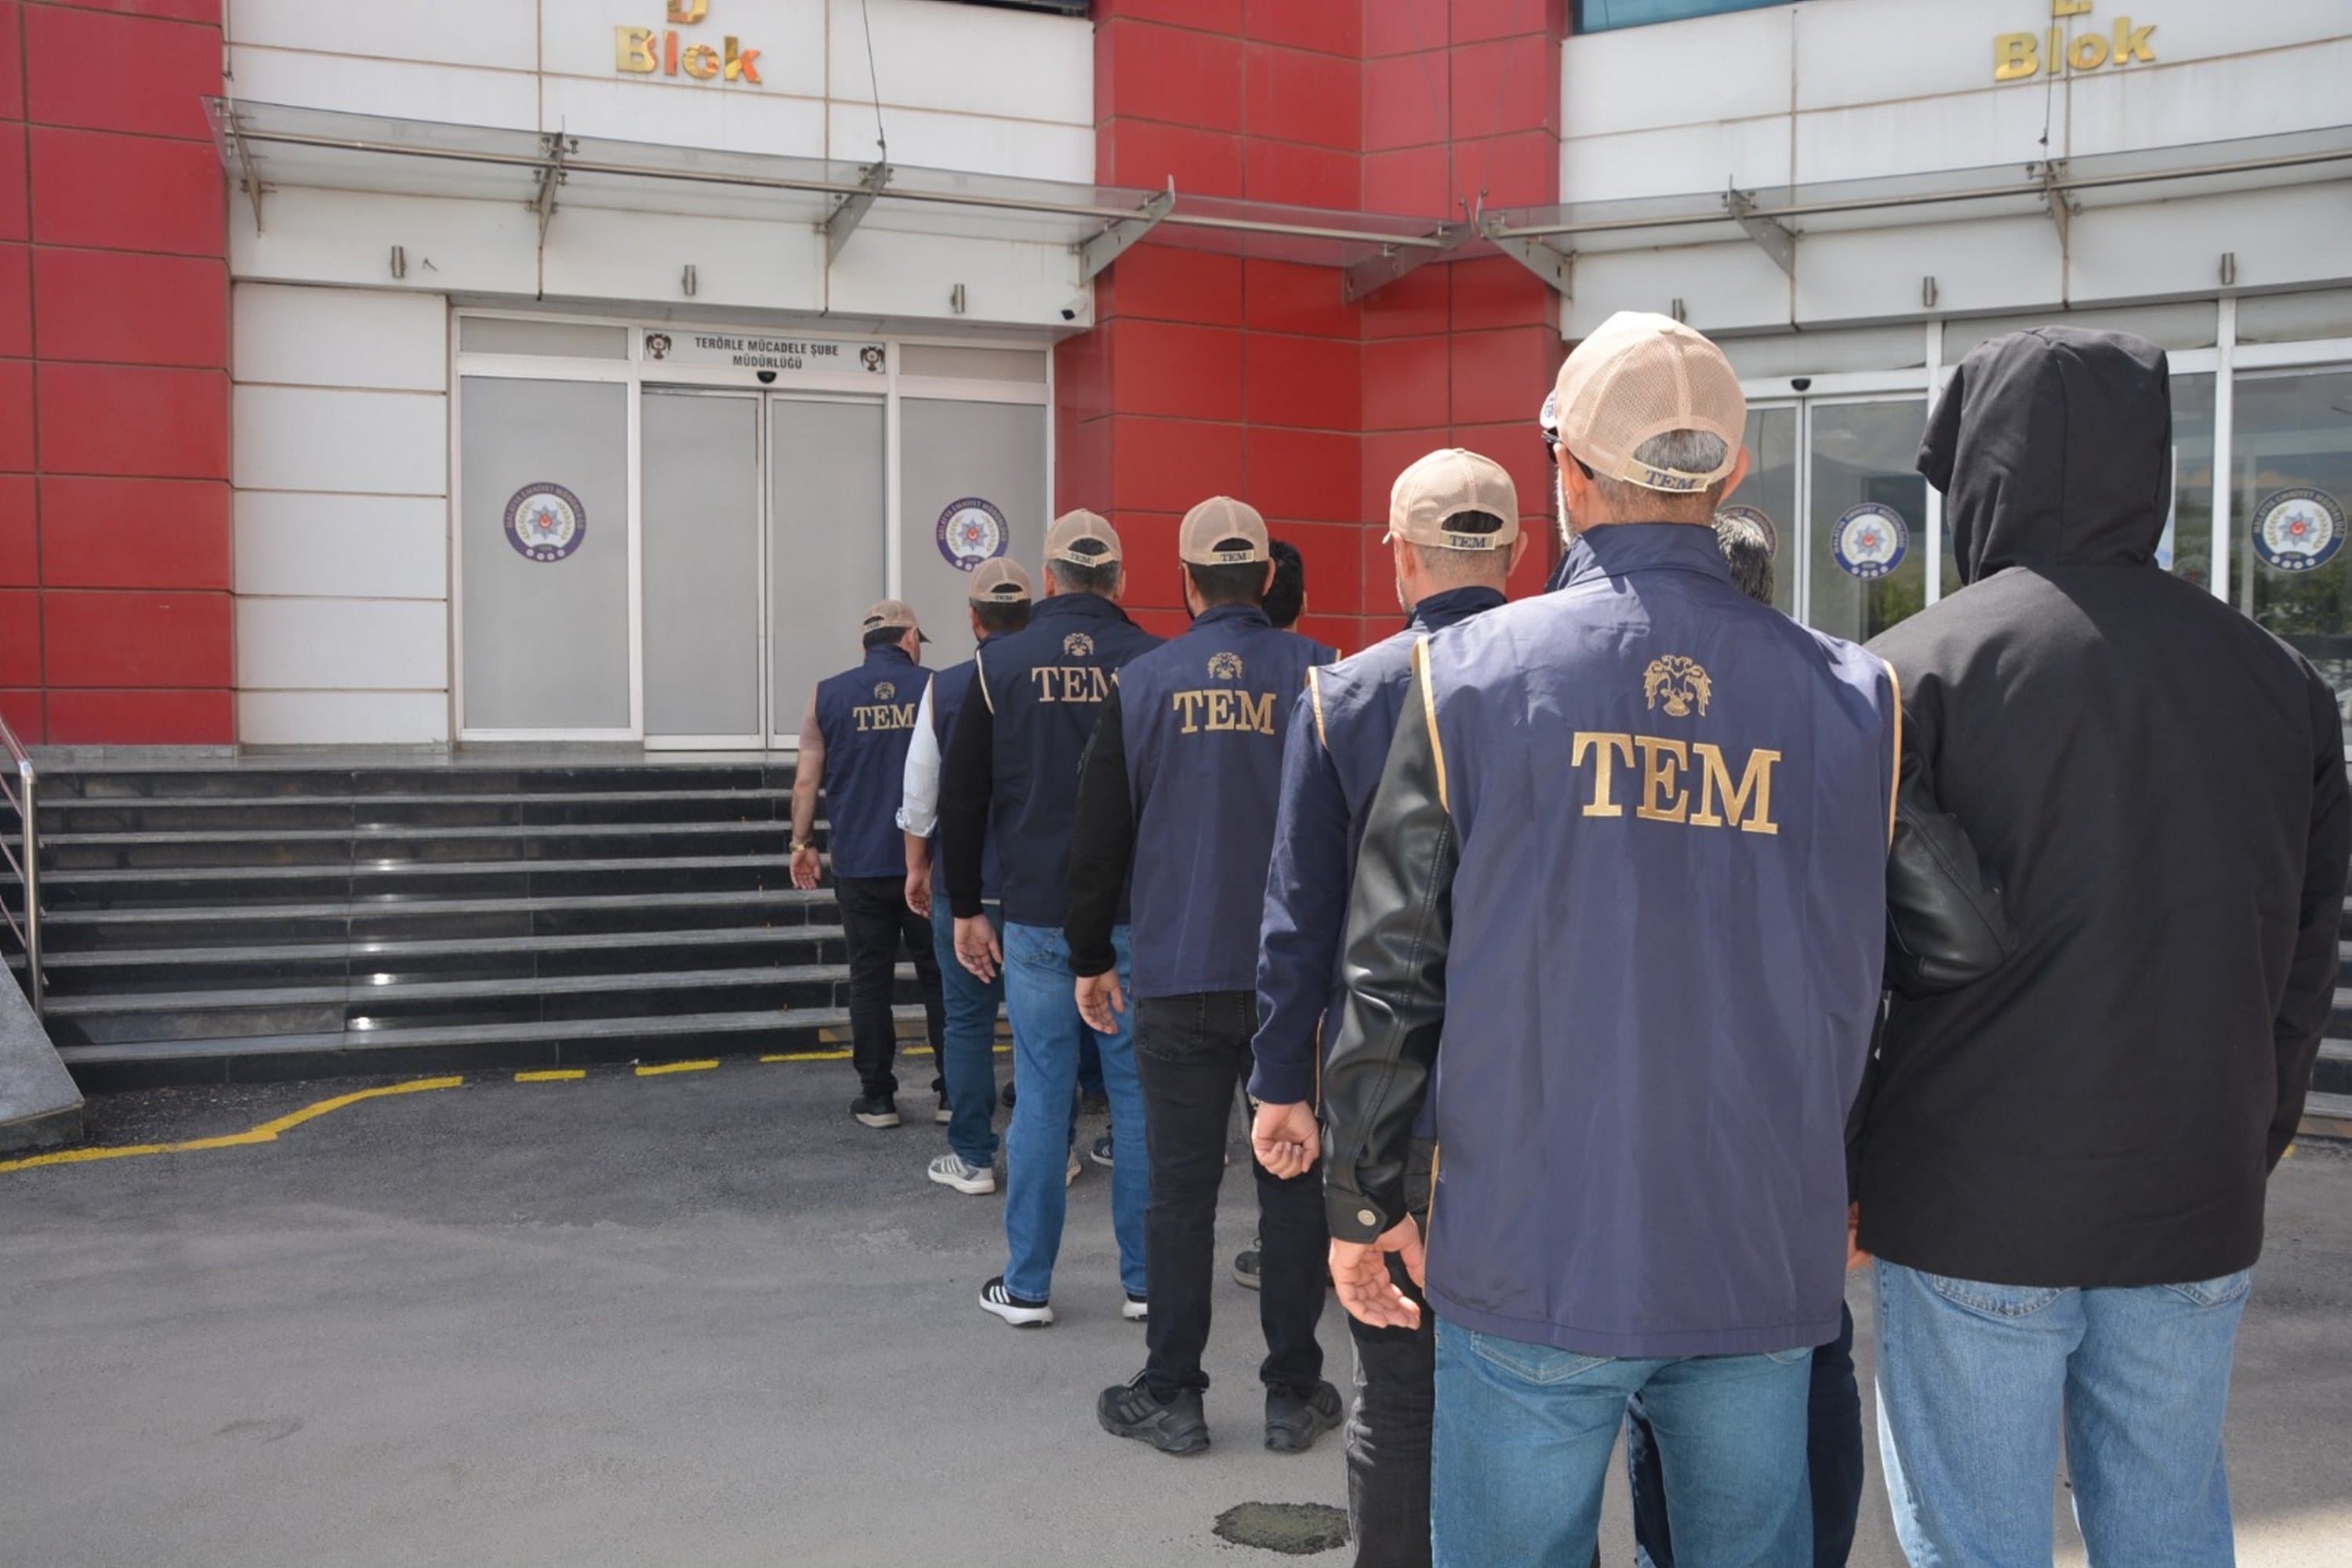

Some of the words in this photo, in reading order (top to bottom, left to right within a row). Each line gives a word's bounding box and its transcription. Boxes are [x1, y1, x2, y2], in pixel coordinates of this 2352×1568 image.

[615, 25, 762, 84] Blok
[1994, 16, 2157, 83] Blok
[695, 336, 743, 351] TERÖRLE
[748, 339, 806, 355] MÜCADELE
[810, 343, 839, 358] ŞUBE
[733, 354, 802, 369] MÜDÜRLÜĞÜ
[1645, 470, 1696, 490] TEM
[1450, 535, 1486, 548] TEM
[1220, 553, 1247, 562] TEM
[852, 703, 916, 731] TEM
[1173, 689, 1277, 735] TEM
[1571, 731, 1781, 834] TEM
